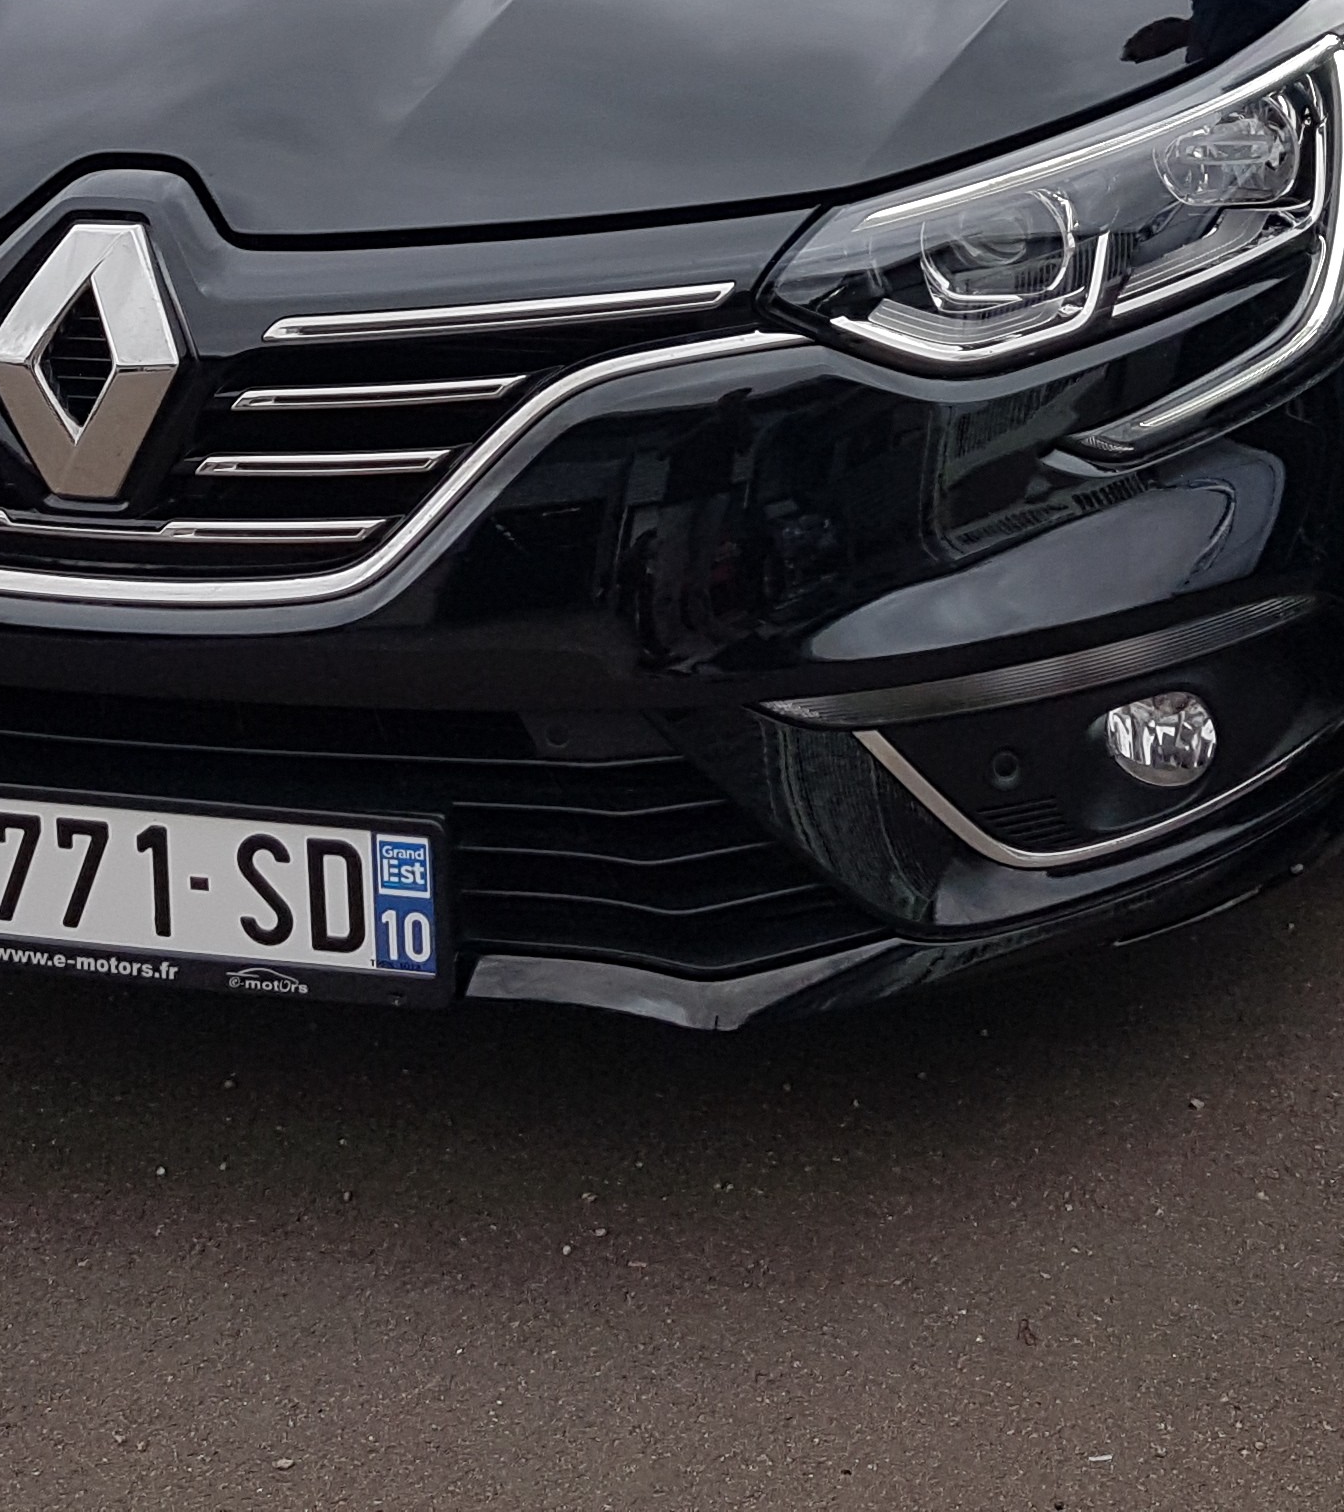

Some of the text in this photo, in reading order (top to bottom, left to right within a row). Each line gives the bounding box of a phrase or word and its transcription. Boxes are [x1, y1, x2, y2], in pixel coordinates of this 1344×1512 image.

[381, 844, 425, 861] Grand
[382, 858, 425, 885] Est
[381, 909, 431, 963] 10
